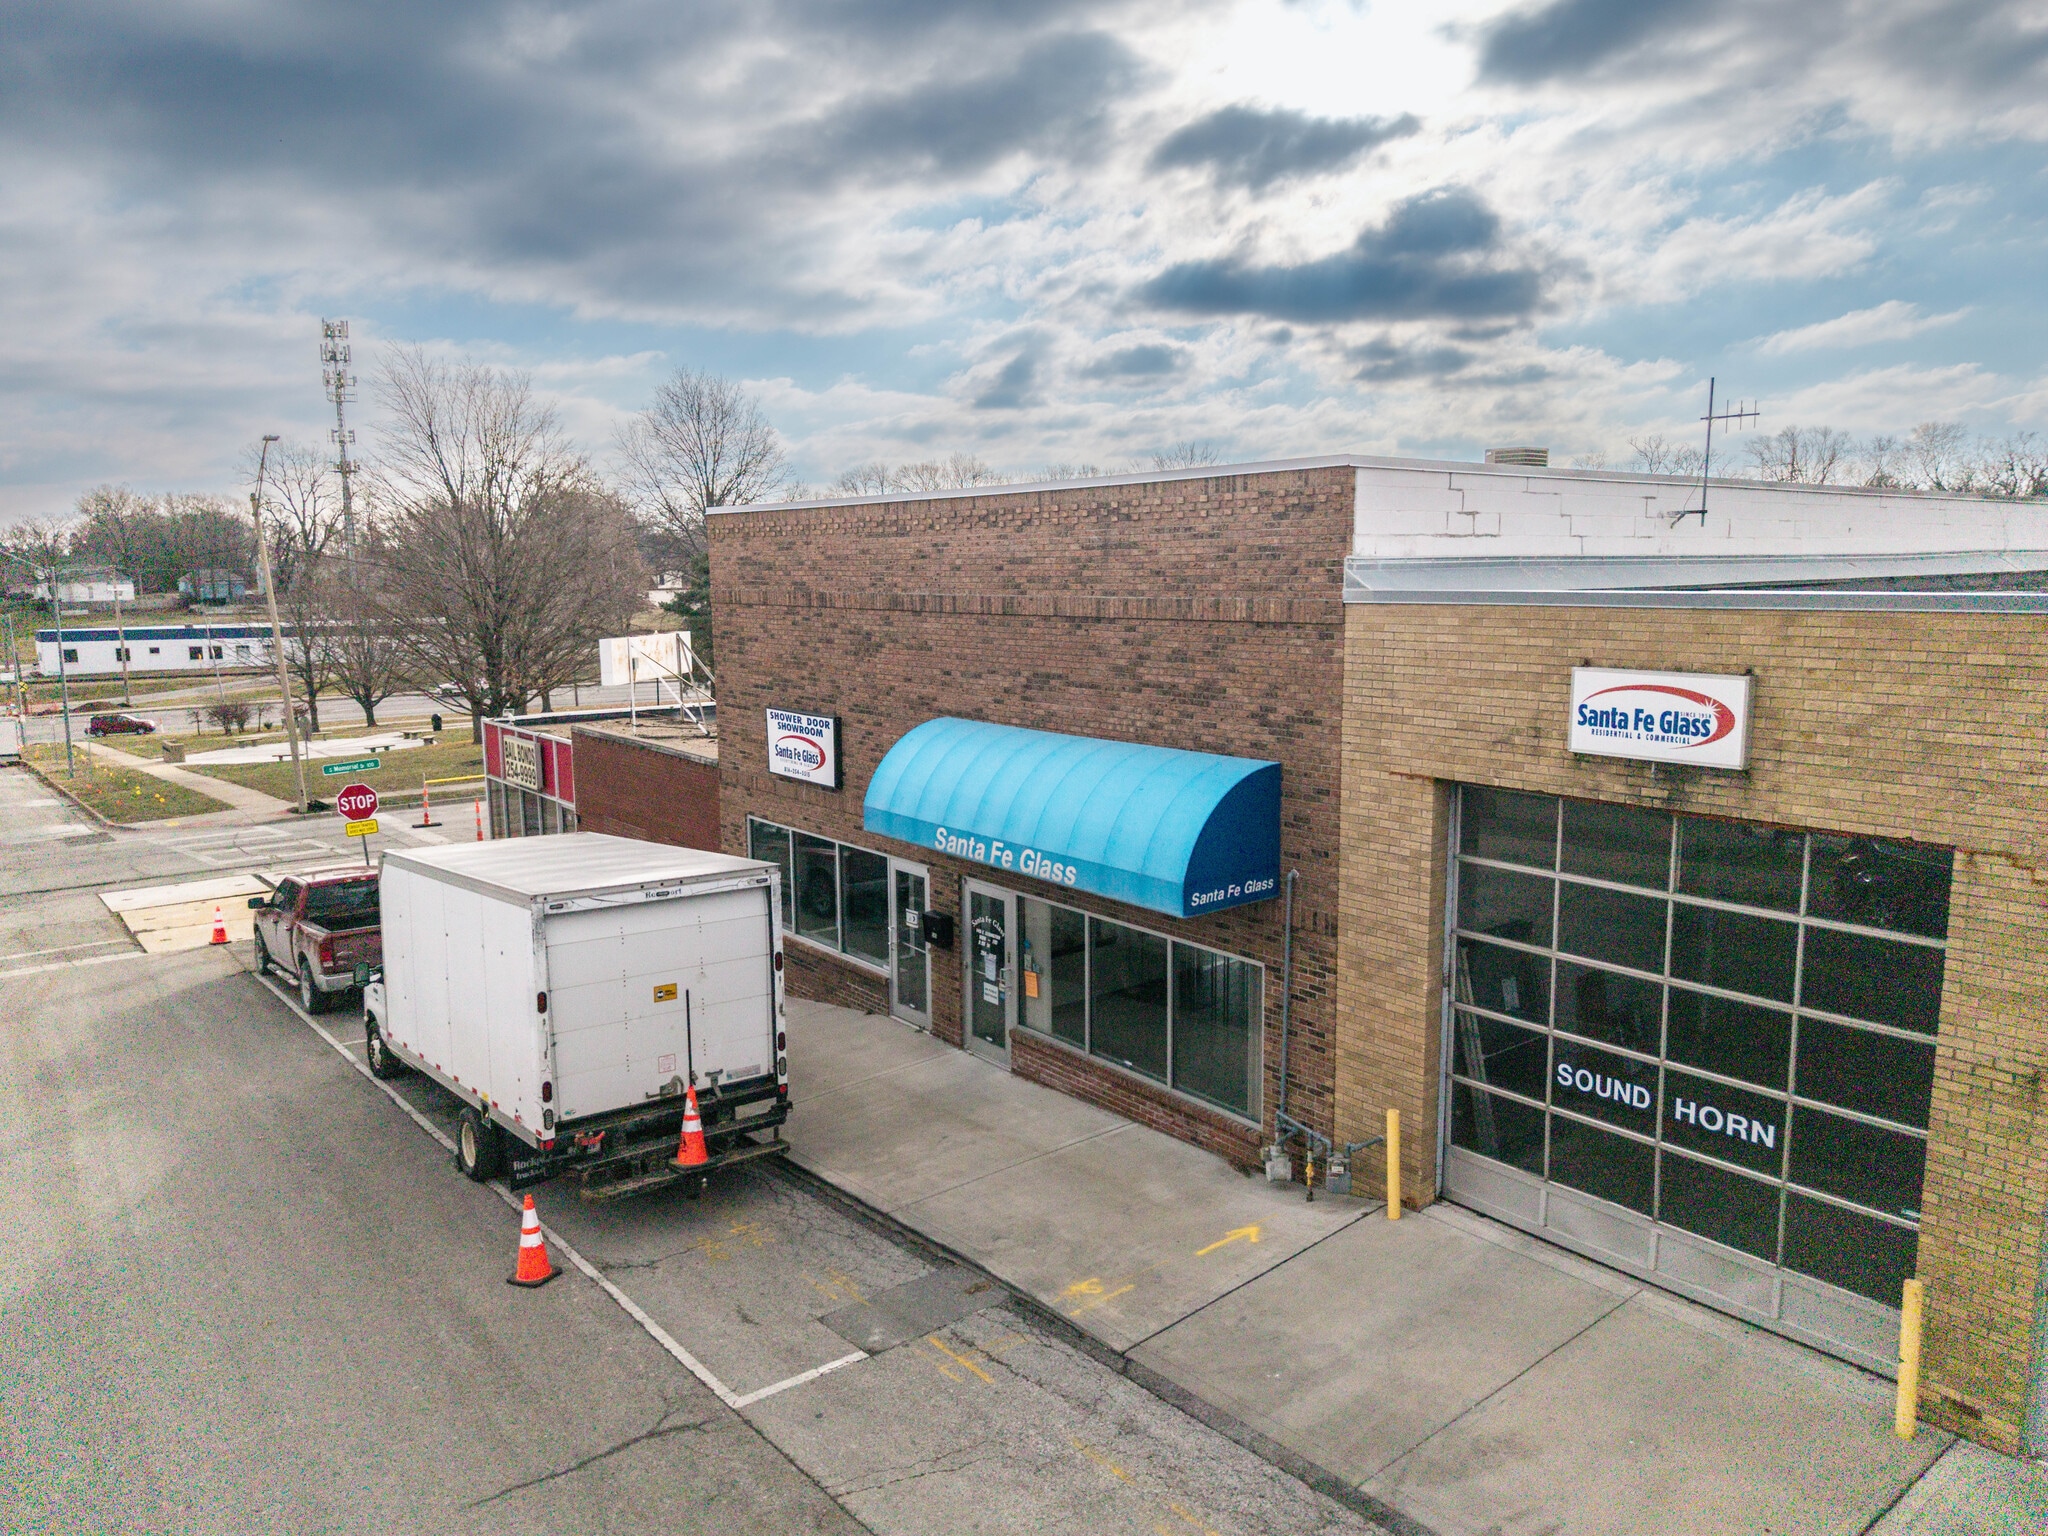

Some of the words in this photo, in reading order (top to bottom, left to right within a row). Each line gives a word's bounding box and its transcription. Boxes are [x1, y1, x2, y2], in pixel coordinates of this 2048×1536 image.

[770, 711, 802, 725] SHOWER
[806, 718, 831, 729] DOOR
[777, 722, 824, 737] SHOWROOM
[1578, 703, 1628, 730] Santa
[1633, 708, 1655, 732] Fe
[1660, 711, 1711, 738] Glass
[1591, 728, 1633, 739] RESIDENTIAL
[1646, 733, 1691, 745] COMMERCIAL
[504, 740, 517, 761] BAIL
[517, 744, 535, 767] BONDS
[775, 744, 793, 759] Santa
[794, 748, 801, 762] Fe
[802, 749, 819, 765] Glass
[333, 764, 359, 772] Memorial
[506, 760, 537, 786] 254-9999
[340, 794, 375, 811] STOP
[935, 827, 985, 862] Santa
[989, 842, 1013, 869] Fe
[1019, 848, 1078, 886] Glass
[1191, 888, 1225, 907] Santa
[1227, 885, 1241, 898] Fe
[1244, 877, 1275, 895] Glass
[1557, 1063, 1651, 1109] SOUND
[1674, 1098, 1775, 1148] HORN
